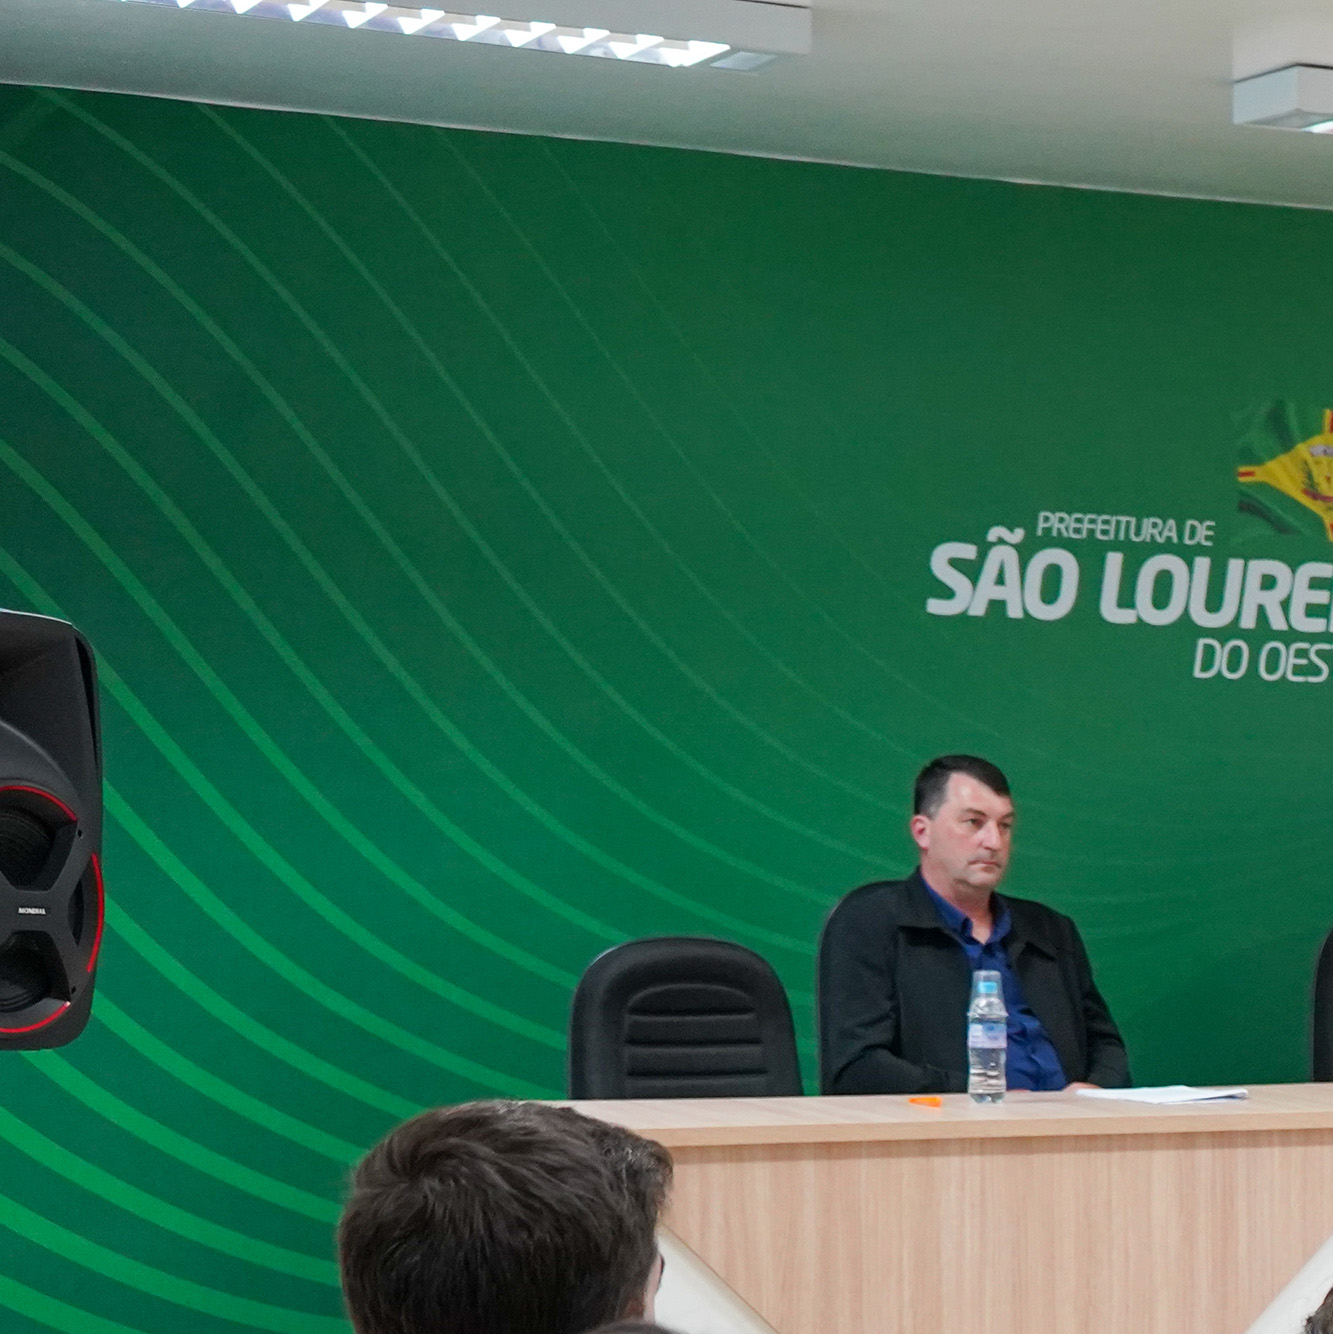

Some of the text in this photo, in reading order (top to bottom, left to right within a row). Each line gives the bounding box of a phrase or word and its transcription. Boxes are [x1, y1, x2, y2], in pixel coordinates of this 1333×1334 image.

[1036, 511, 1216, 546] PREFEITURA DE
[926, 526, 1080, 621] SÃO
[1192, 638, 1250, 681] DO
